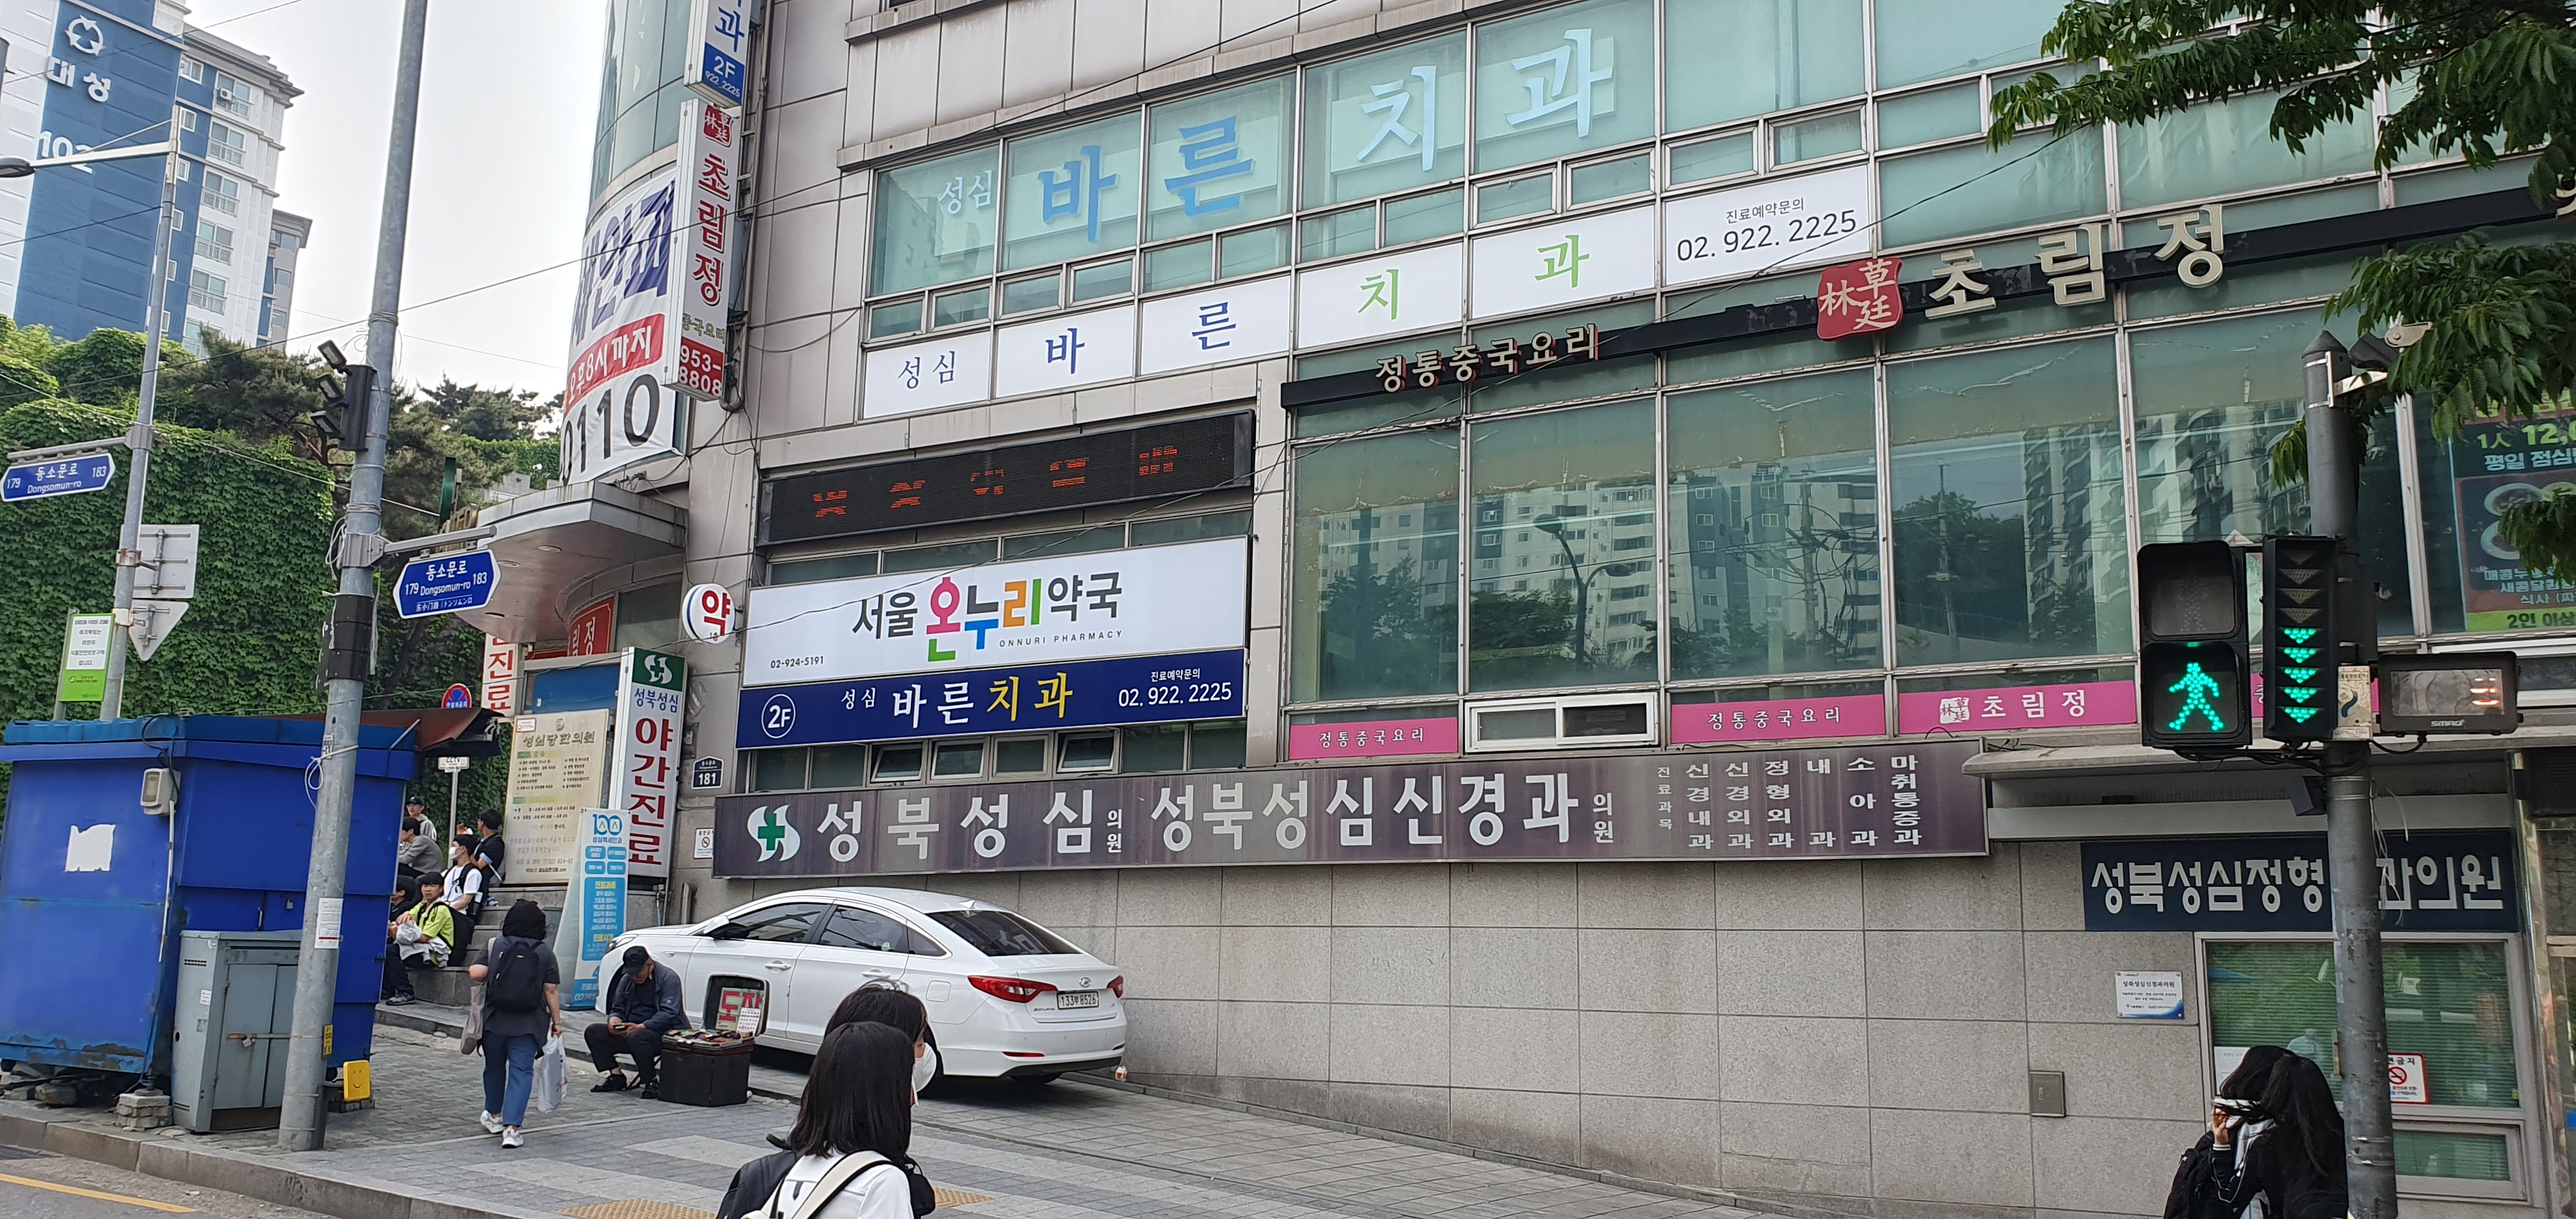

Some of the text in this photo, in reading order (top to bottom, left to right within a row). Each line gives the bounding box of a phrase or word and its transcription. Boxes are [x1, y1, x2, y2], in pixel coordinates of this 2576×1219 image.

[46, 56, 112, 103] 대성
[713, 55, 737, 78] 2F
[36, 129, 94, 174] 102
[937, 169, 995, 216] 성심
[1725, 197, 1805, 226] 진료예약문의
[693, 153, 732, 307] 초림정
[1677, 208, 1857, 261] 02. 922. 2225
[1924, 203, 2225, 321] 초림정
[682, 312, 726, 345] 중국요리
[680, 344, 722, 372] 953-
[897, 349, 956, 390] 성심
[1375, 323, 1598, 394] 정통중국요리
[678, 366, 723, 397] 8808
[35, 463, 79, 482] 동소문로
[2484, 452, 2526, 471] 평일
[6, 466, 107, 494] 179 Dongsomun-ro 183
[405, 572, 487, 597] 179 Dongsomun-ro 183
[425, 560, 468, 581] 동소문로
[702, 590, 731, 636] 약
[2520, 593, 2550, 604] 식사
[2506, 613, 2537, 629] 2인
[999, 629, 1123, 648] ONNURI PHARMACY
[770, 656, 824, 670] 02-924-5191
[1150, 667, 1201, 682] 진료예약문의
[633, 687, 679, 714] 성북성심
[767, 705, 791, 728] 2F
[841, 687, 877, 709] 성심
[1119, 682, 1232, 707] 02. 922. 2225
[1981, 690, 2086, 718] 초림정
[1706, 706, 1841, 731] 정통중국요리
[523, 731, 595, 748] 성심당한의원
[1319, 727, 1424, 749] 정통중국요리
[628, 717, 675, 866] 야간진료
[698, 772, 717, 785] 181
[1107, 808, 1123, 854] 의원
[1150, 772, 1579, 852] 성북성심신경과
[1593, 792, 1614, 844] 의원
[1657, 766, 1673, 830] 진료과목
[1685, 763, 1713, 850] 신경내과
[1724, 762, 1754, 848] 신경외과
[1764, 760, 1795, 848] 정형외과
[1806, 758, 1836, 847] 내과
[1846, 757, 1878, 847] 소아과
[1890, 754, 1922, 845] 마취통증과
